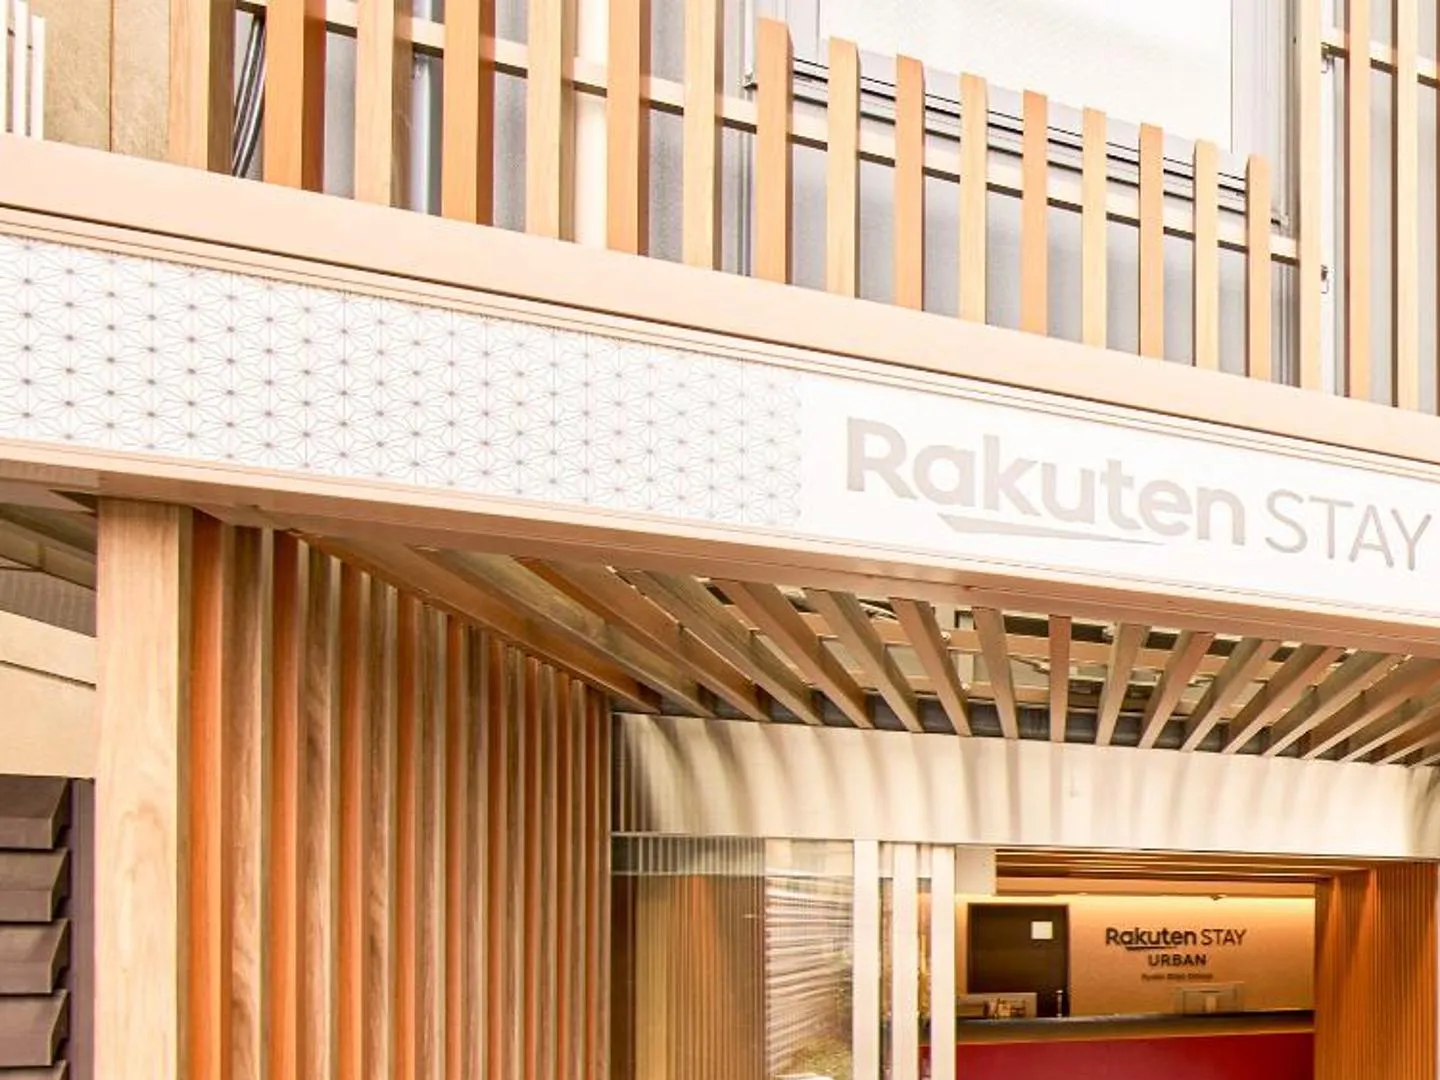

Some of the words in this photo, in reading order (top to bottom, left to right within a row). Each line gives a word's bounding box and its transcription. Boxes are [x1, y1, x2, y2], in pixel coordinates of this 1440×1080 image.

[846, 416, 1245, 547] Rakuten
[1265, 489, 1433, 571] STAY
[1105, 927, 1198, 951] Rakuten
[1200, 928, 1247, 946] STAY
[1148, 953, 1207, 967] URBAN
